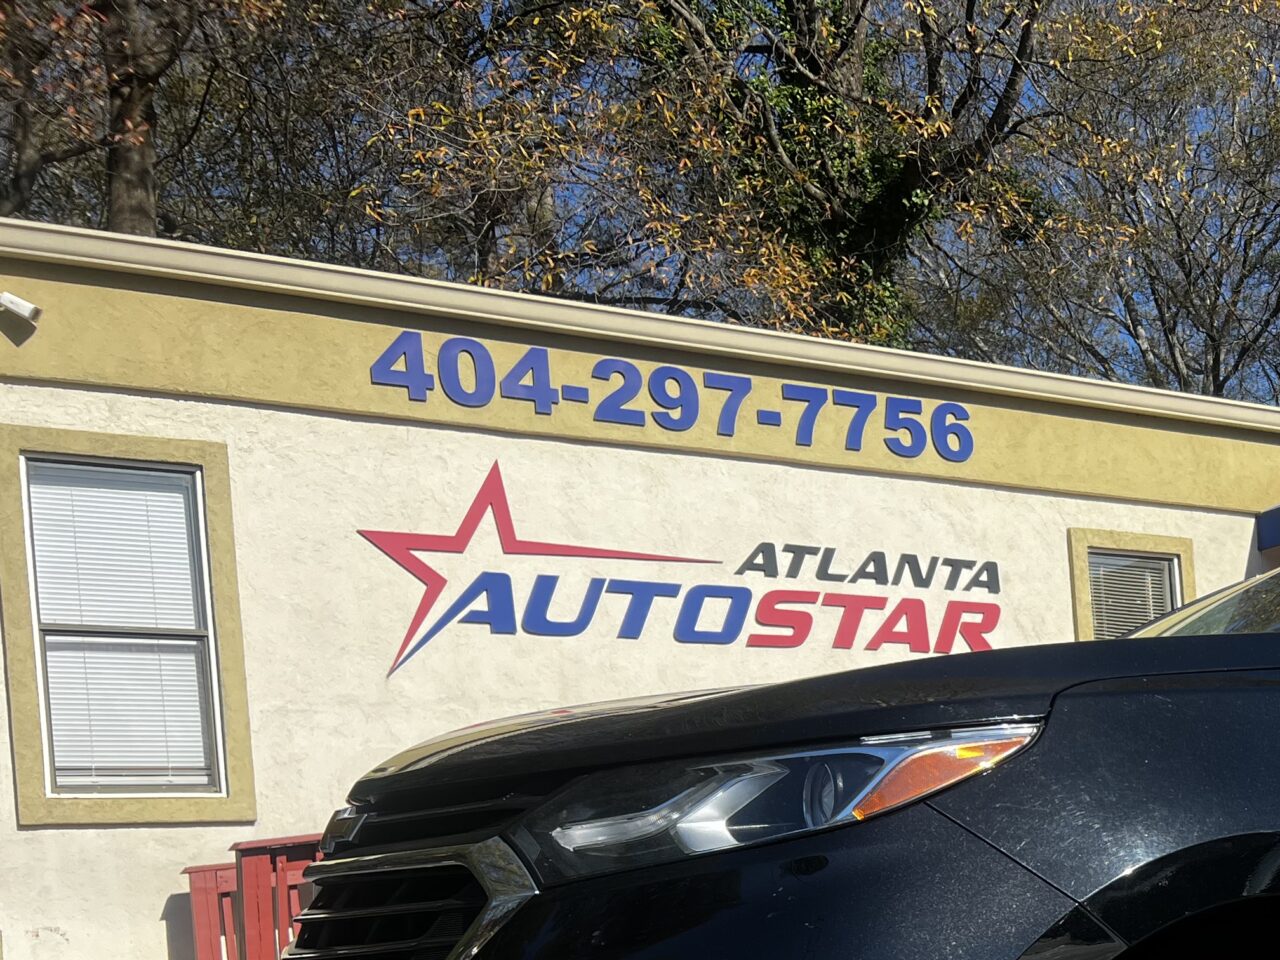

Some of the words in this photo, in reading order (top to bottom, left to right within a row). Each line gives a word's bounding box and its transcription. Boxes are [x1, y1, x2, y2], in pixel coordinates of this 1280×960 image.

[370, 330, 975, 463] 404-297-7756
[734, 542, 1001, 593] ATLANTA
[436, 570, 1002, 656] AUTOSTAR
